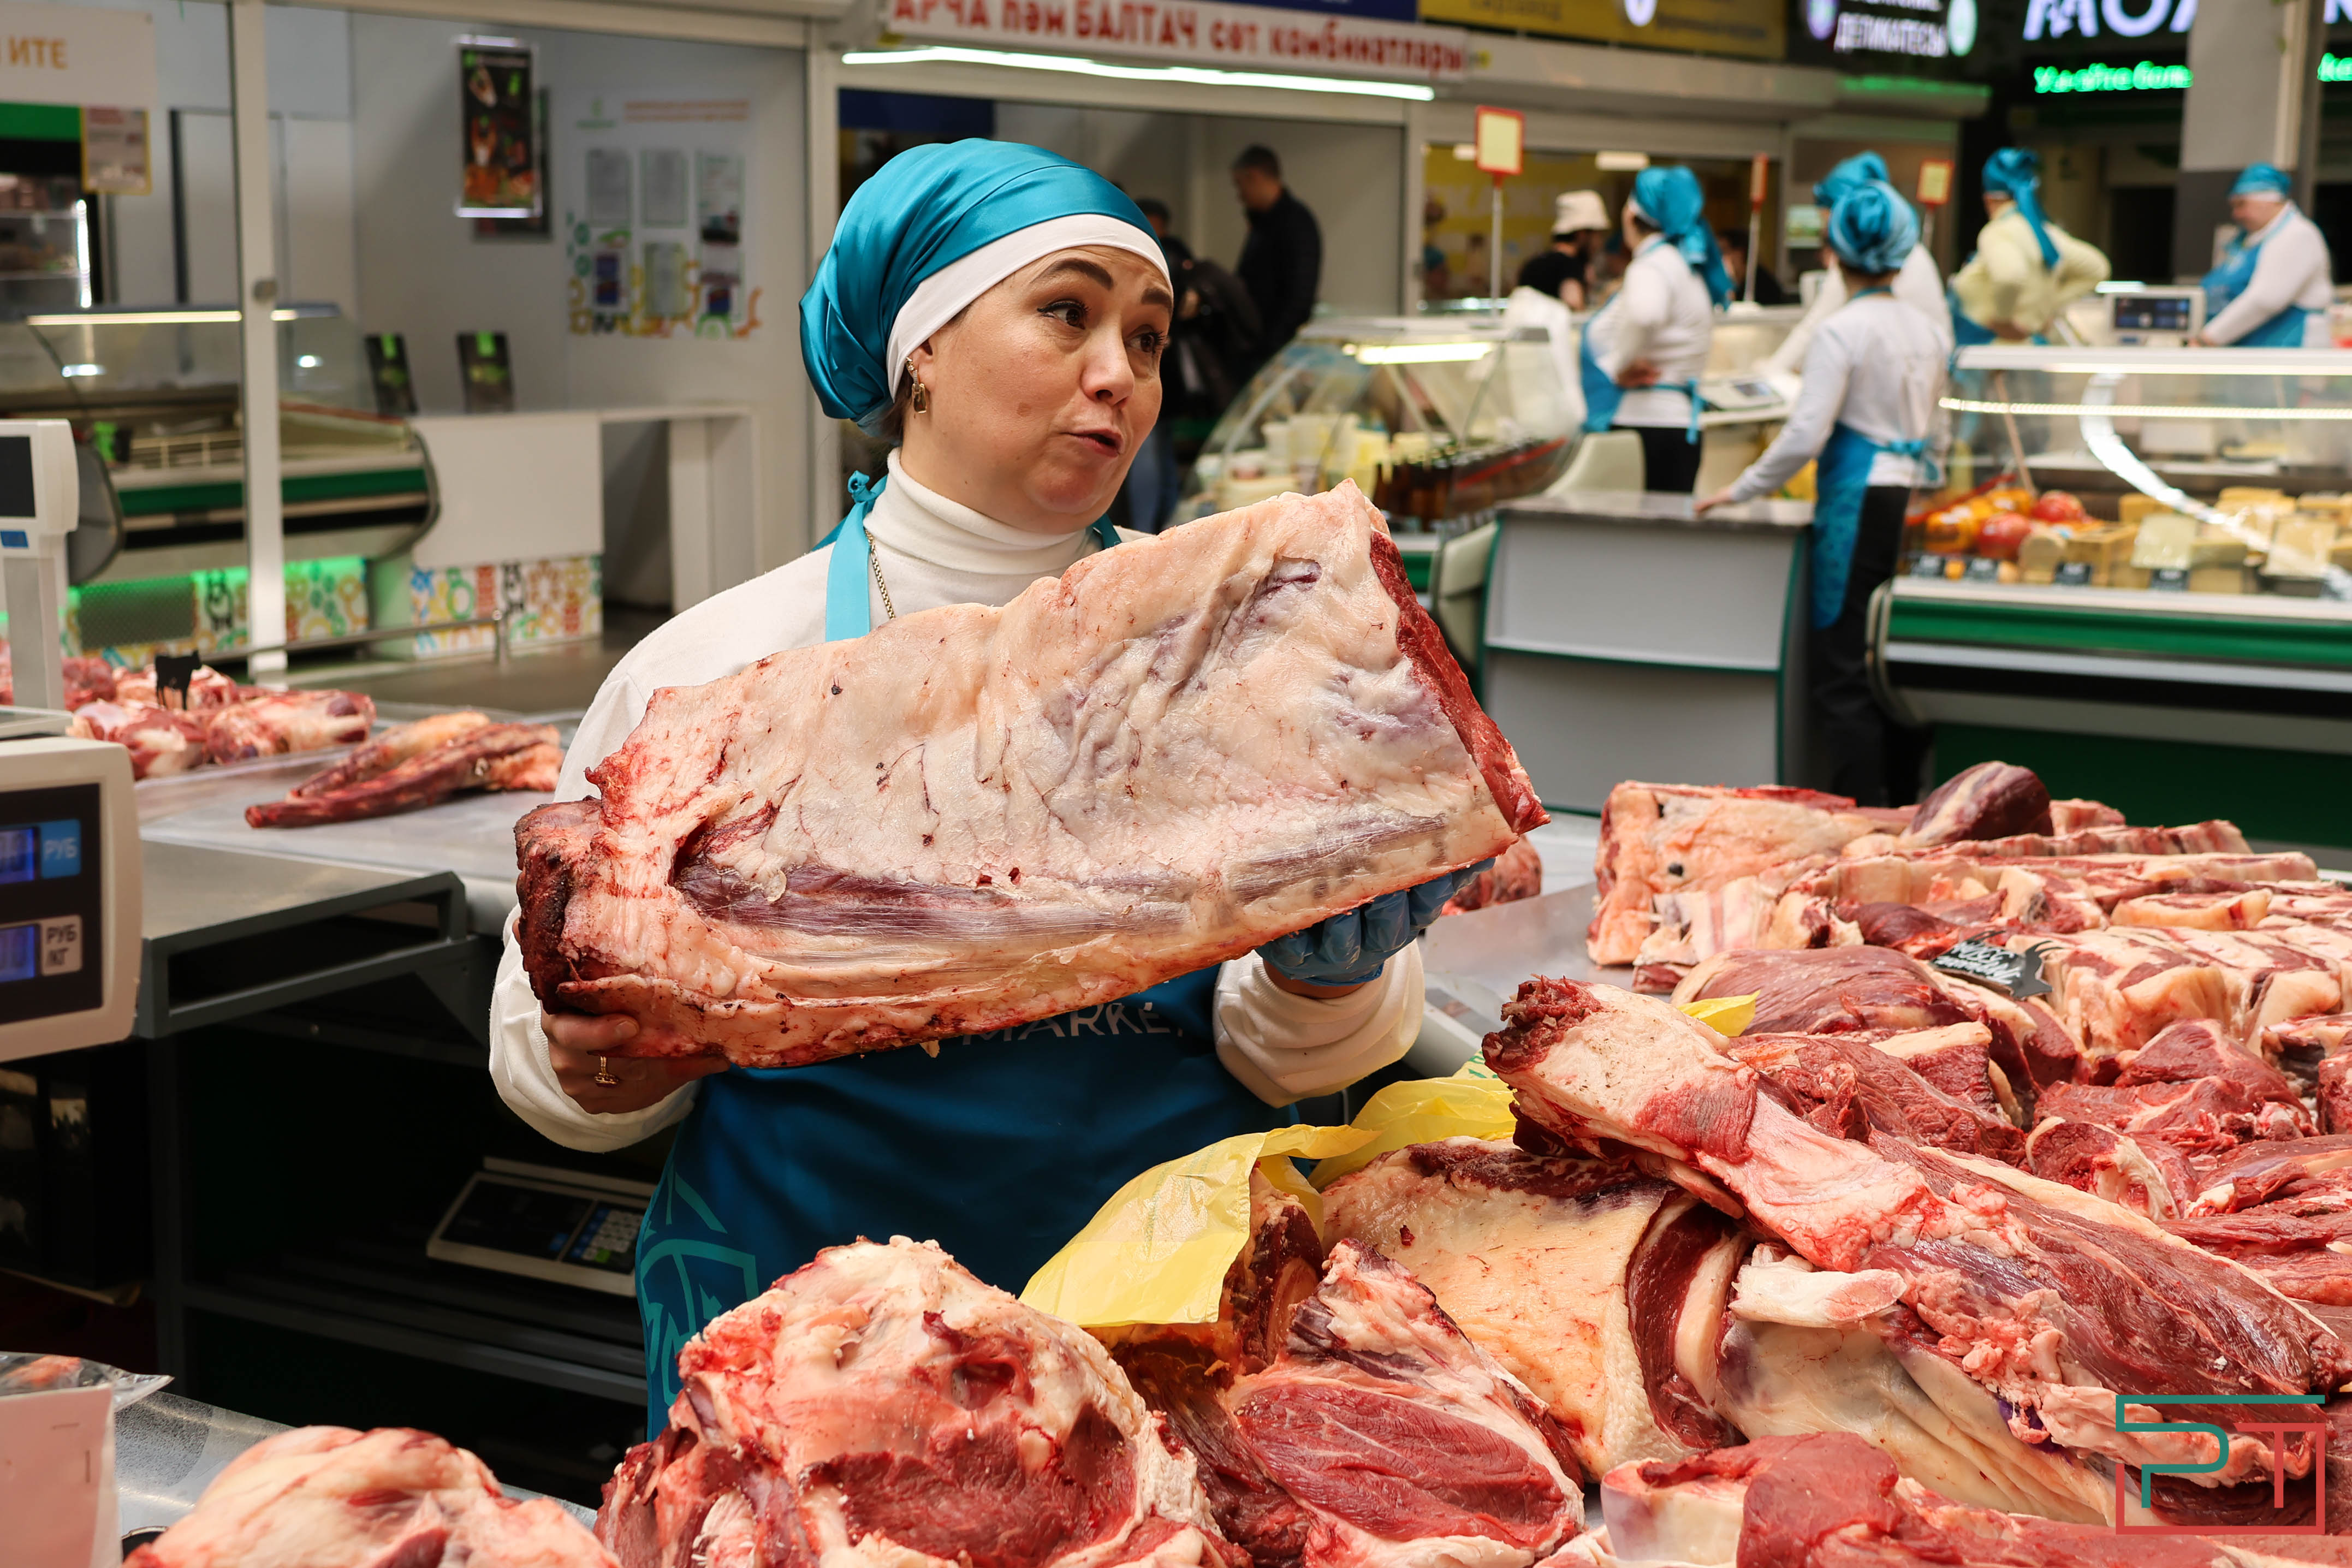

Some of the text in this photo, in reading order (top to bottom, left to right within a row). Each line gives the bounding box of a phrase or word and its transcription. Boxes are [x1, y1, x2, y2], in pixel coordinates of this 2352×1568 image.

[1074, 0, 1198, 49] БАЛТАЧ
[1834, 12, 1948, 57] ДЕЛИКАТЕСЫ
[2022, 0, 2197, 40] МО
[962, 1002, 1183, 1046] ARKE
